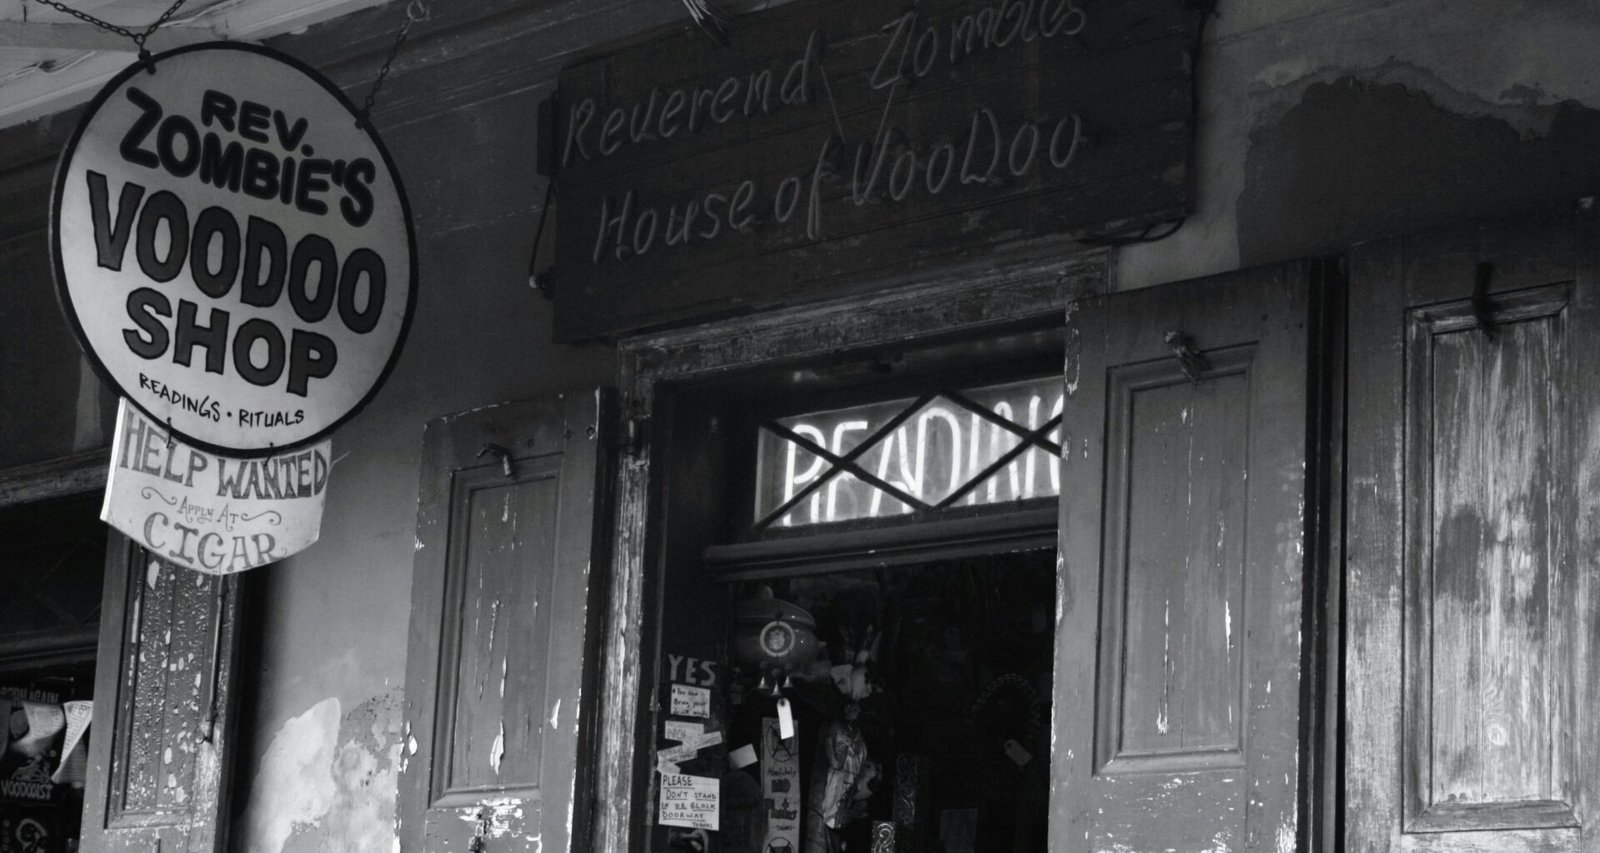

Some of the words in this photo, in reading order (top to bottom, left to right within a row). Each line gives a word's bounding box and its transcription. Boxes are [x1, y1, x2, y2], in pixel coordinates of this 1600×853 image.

[201, 88, 314, 157] REV.
[562, 28, 818, 168] Reverend
[119, 86, 376, 228] ZOMBIE'S
[593, 180, 756, 264] House
[775, 135, 833, 240] of
[86, 169, 387, 334] VOODOO
[122, 286, 338, 397] SHOP
[139, 372, 221, 423] READINGS
[238, 409, 305, 428] RITUALS
[119, 410, 208, 488] HELP
[216, 449, 328, 500] WANTED
[781, 394, 1062, 527] READIN
[143, 511, 283, 572] CIGAR
[668, 654, 717, 686] YES
[0, 779, 54, 800] VOODOOIST
[662, 774, 693, 787] PLEASE
[690, 801, 716, 810] BLOCK
[694, 791, 717, 800] STAND
[662, 811, 705, 819] DOORWAY
